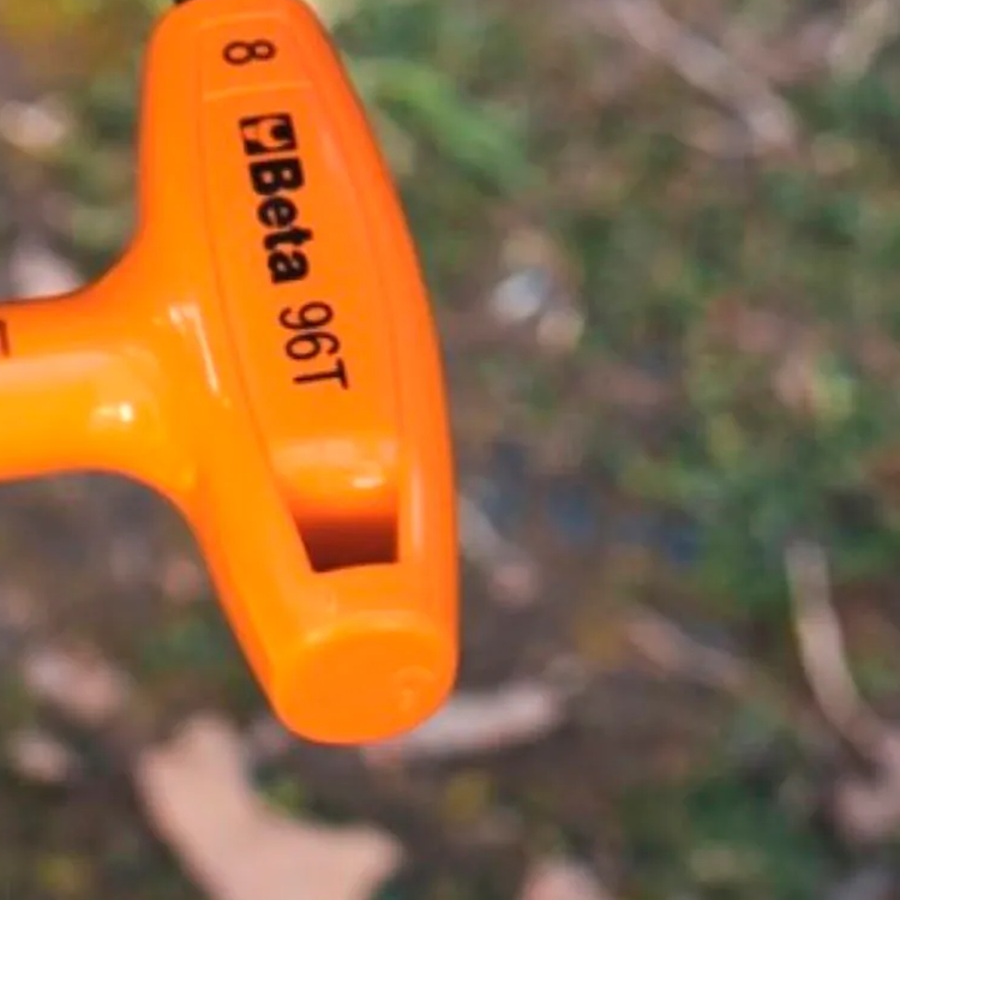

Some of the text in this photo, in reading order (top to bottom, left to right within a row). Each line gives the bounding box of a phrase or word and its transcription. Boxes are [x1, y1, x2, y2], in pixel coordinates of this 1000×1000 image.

[222, 39, 276, 65] 8
[248, 157, 349, 391] Beta 96T
